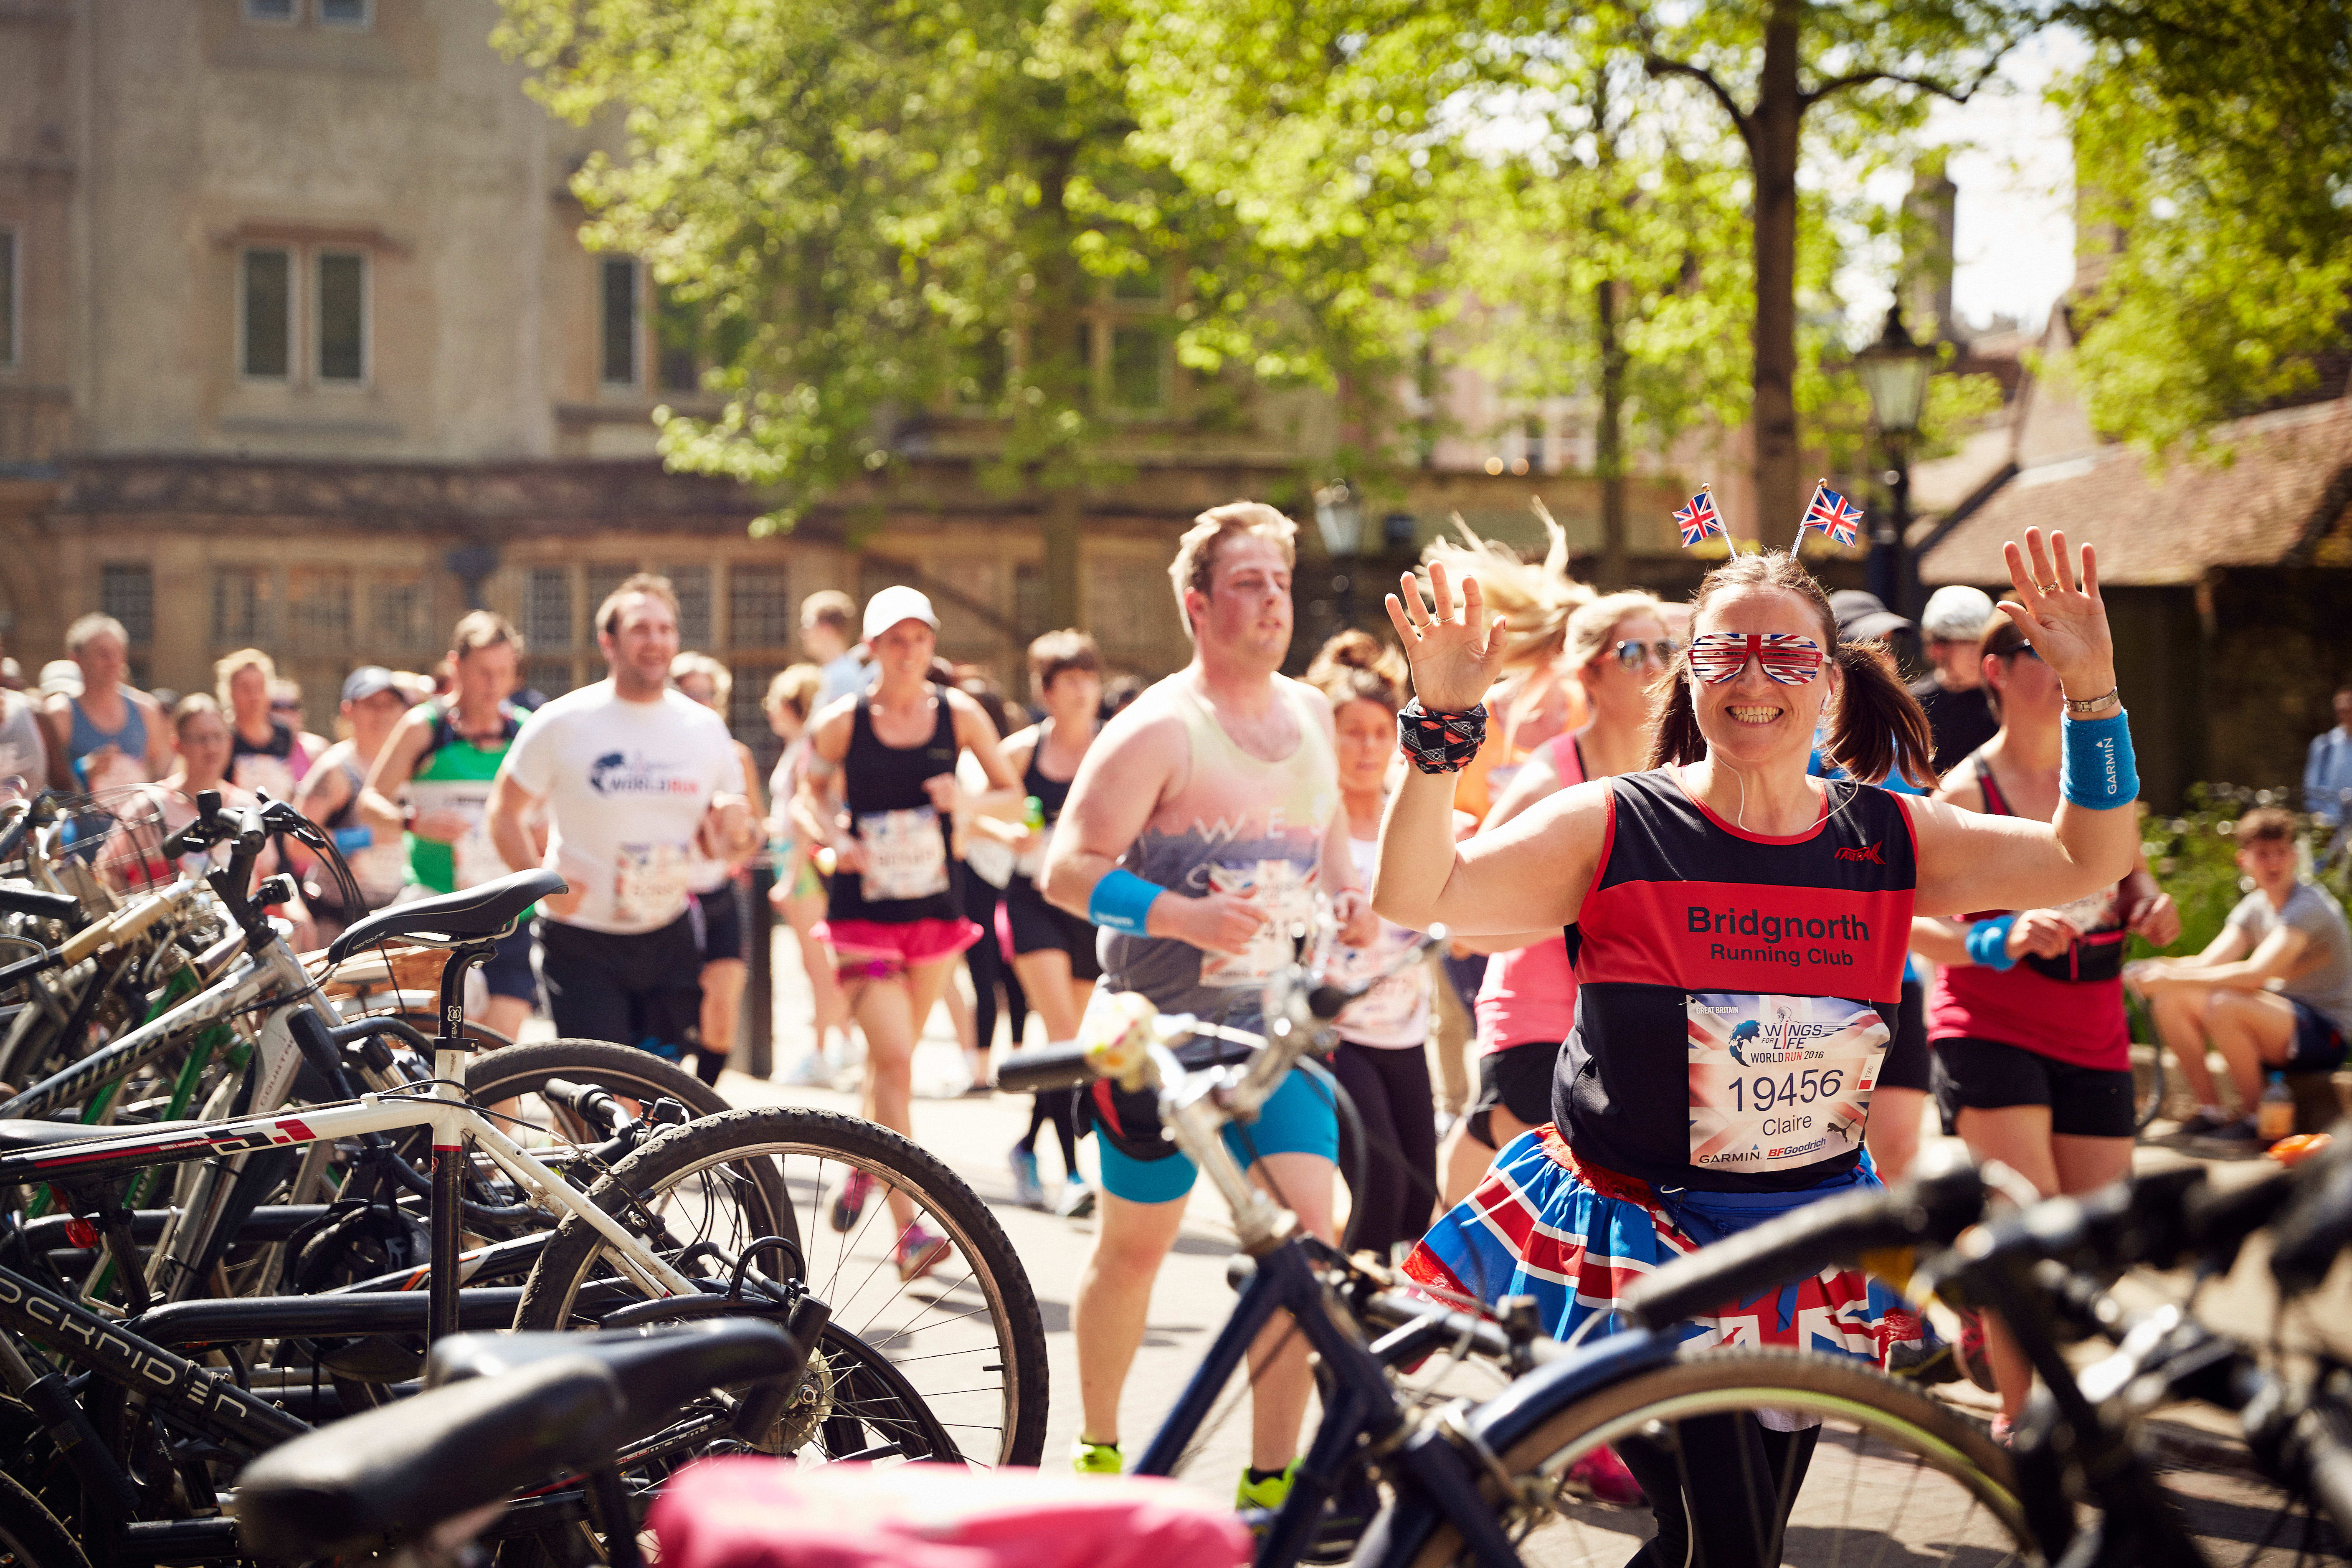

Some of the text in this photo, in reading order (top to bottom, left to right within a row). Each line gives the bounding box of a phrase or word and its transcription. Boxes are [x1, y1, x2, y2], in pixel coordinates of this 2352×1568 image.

[2103, 737, 2117, 794] GARMIN
[1688, 906, 1870, 944] Bridgnorth
[352, 931, 386, 950] sportourer
[1711, 943, 1853, 967] Running Club
[1773, 1037, 1807, 1049] LIFE
[1804, 1051, 1824, 1060] 2016
[1729, 1069, 1844, 1112] 19456
[1763, 1115, 1812, 1136] Claire
[204, 1119, 317, 1155] 5.1
[1768, 1137, 1826, 1157] BFGoodrich
[1699, 1151, 1760, 1163] GARMIN
